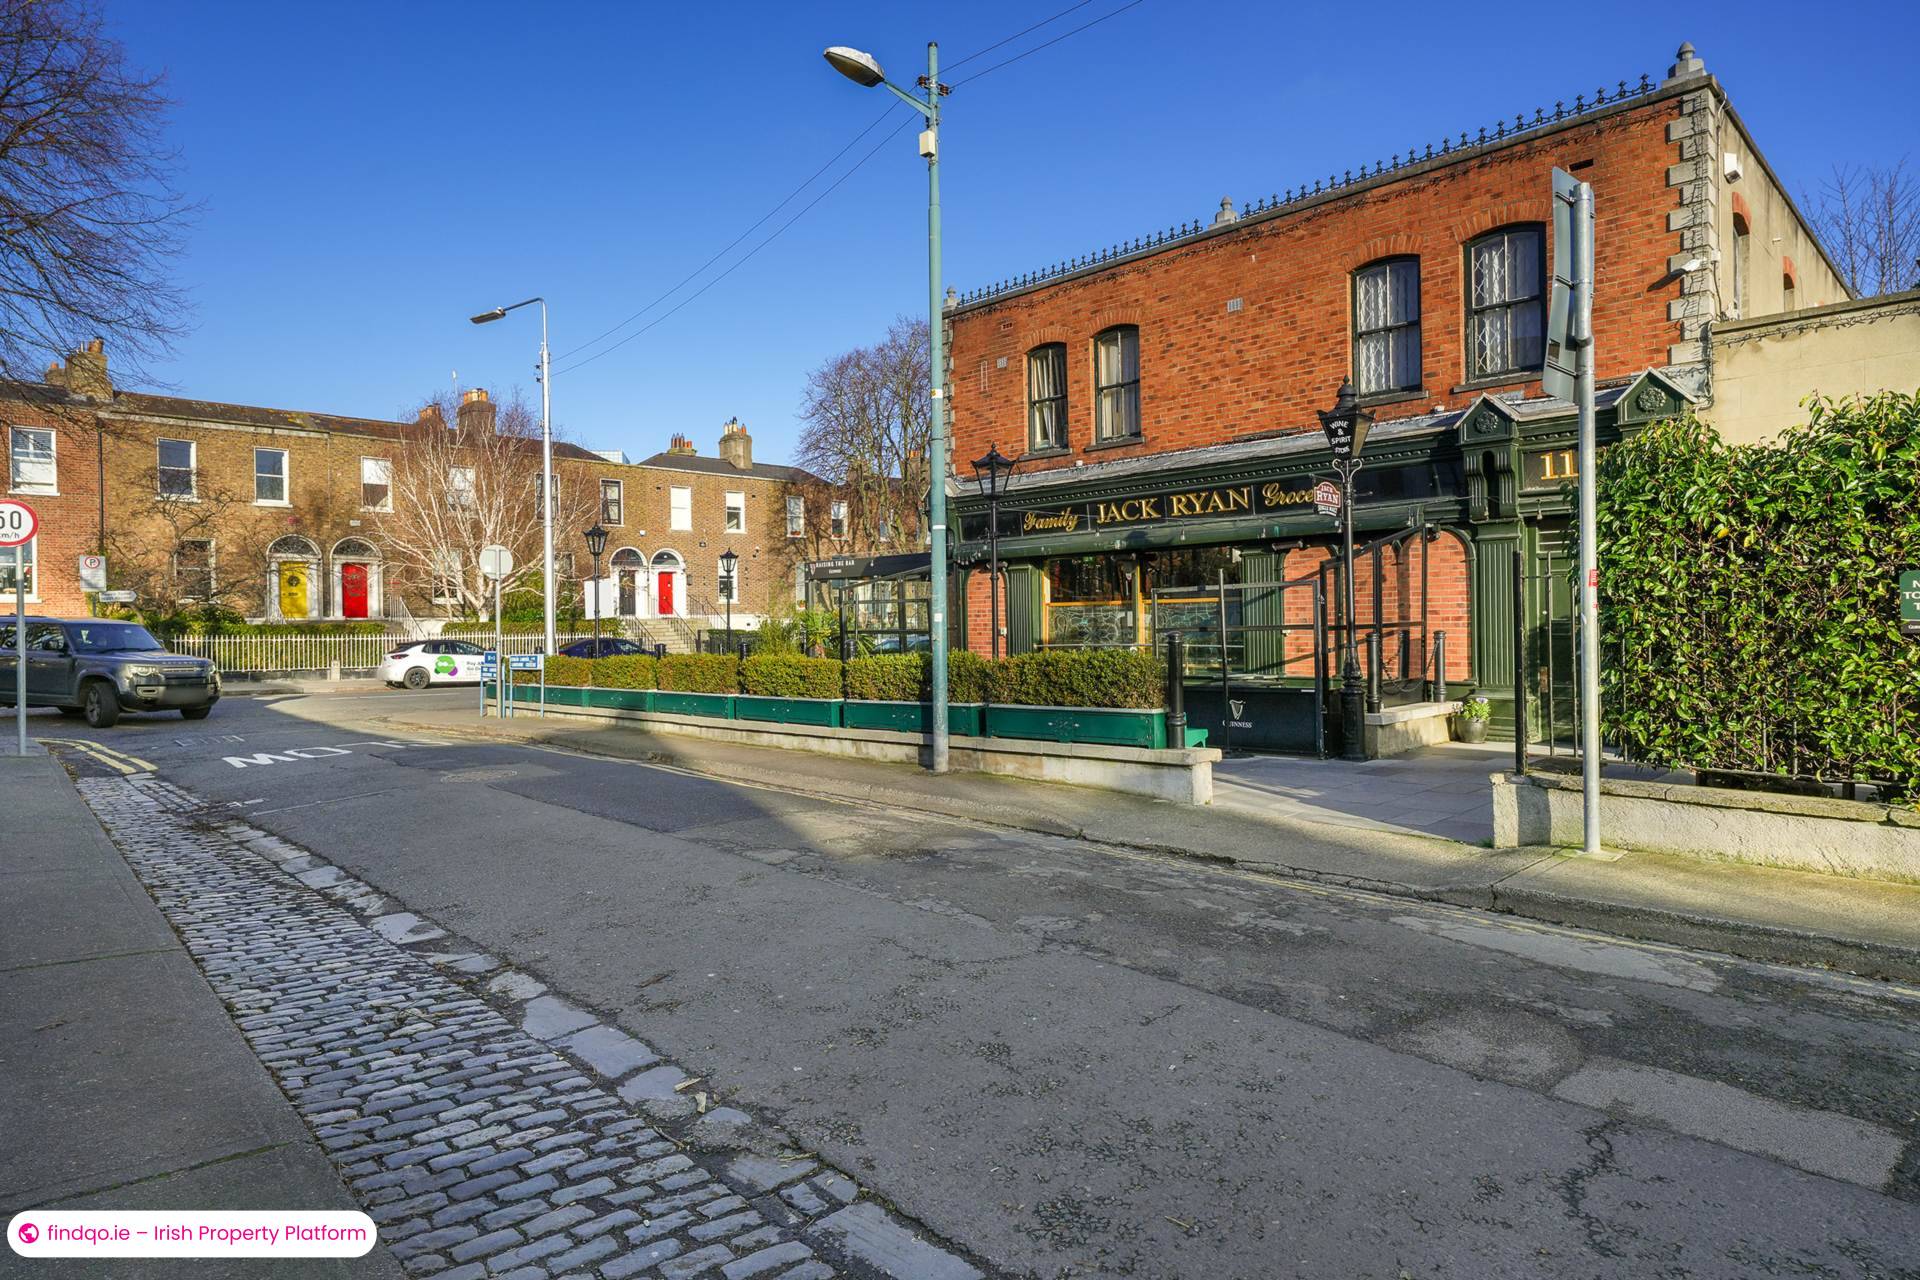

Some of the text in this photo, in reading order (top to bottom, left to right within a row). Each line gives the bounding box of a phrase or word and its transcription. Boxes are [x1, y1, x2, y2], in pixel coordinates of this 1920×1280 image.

[1329, 420, 1349, 429] WINE
[1337, 428, 1345, 436] &
[1331, 435, 1352, 445] SPIRIT
[1316, 490, 1339, 505] RYAN
[1023, 482, 1314, 532] Family JACK RYAN Groce
